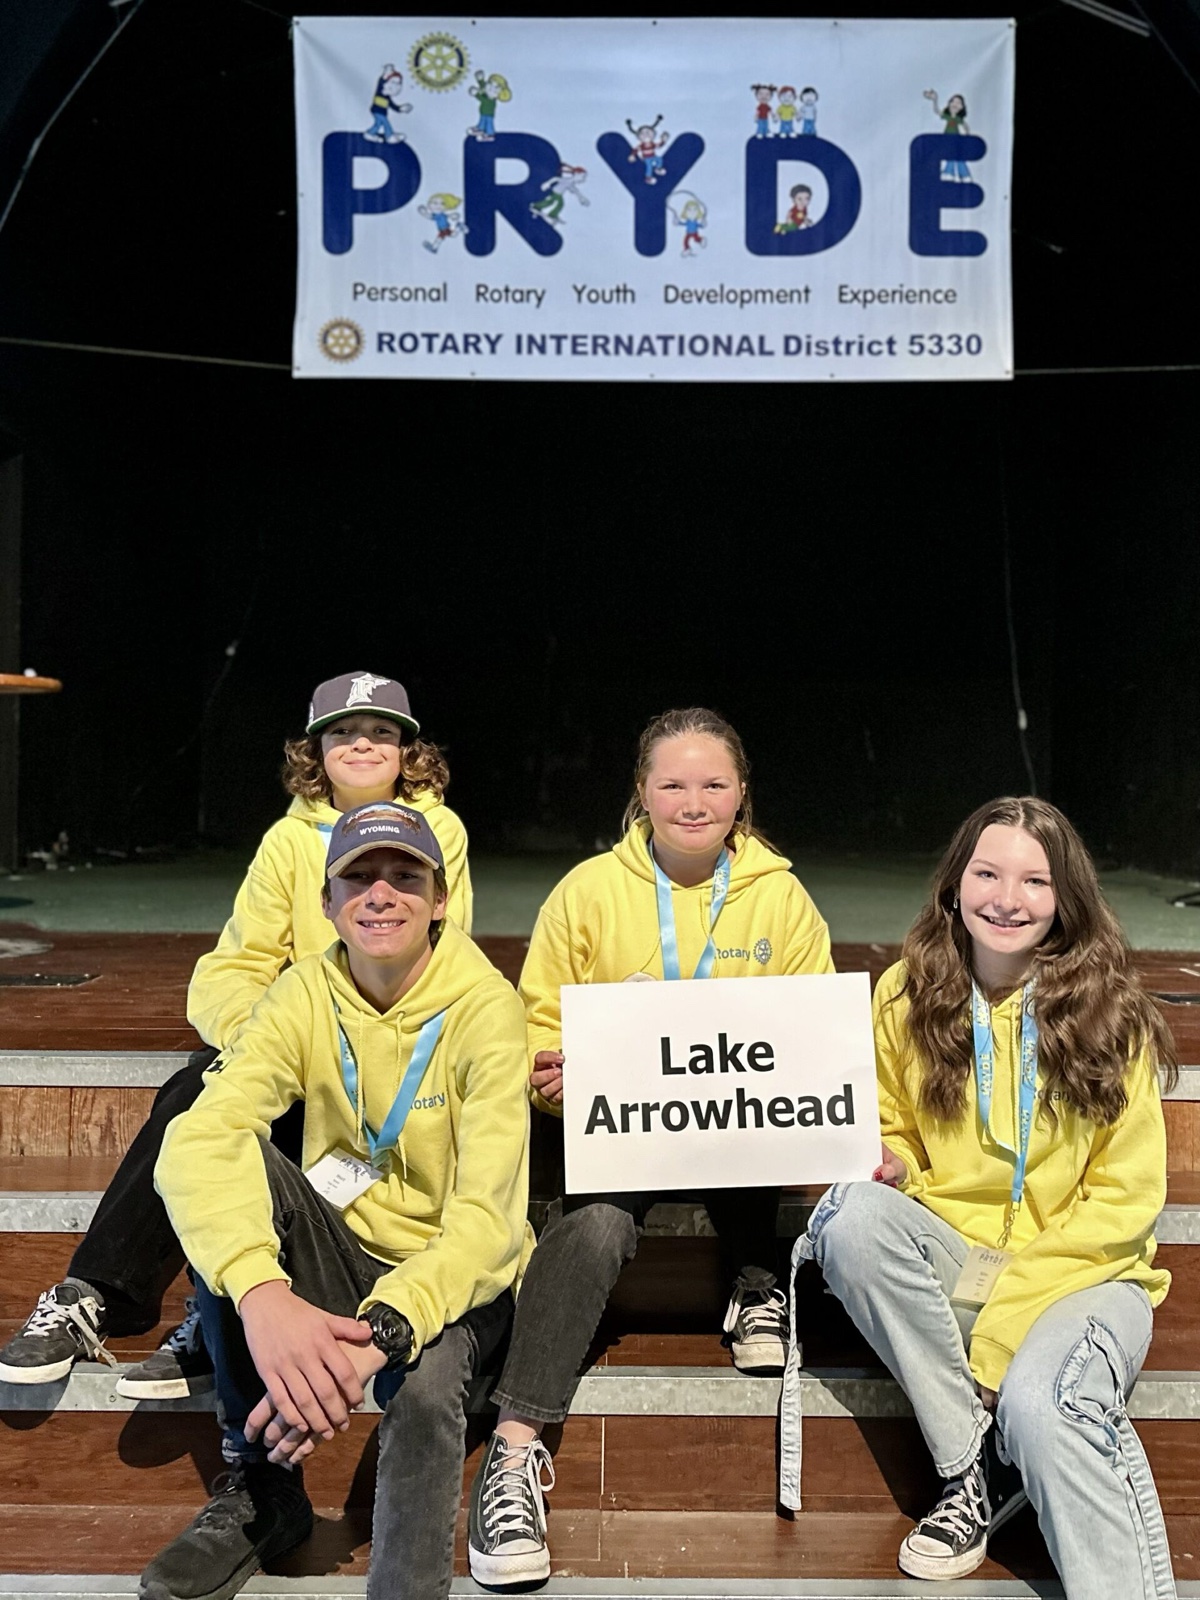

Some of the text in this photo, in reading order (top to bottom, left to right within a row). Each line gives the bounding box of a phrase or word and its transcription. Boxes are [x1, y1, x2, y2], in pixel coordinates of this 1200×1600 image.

[322, 131, 988, 257] PRYDE
[353, 282, 957, 309] Personal Rotary Youth Development Experience
[376, 332, 503, 354] ROTARY
[516, 333, 774, 356] INTERNATIONAL
[783, 334, 897, 356] District
[908, 333, 983, 356] 5330
[360, 825, 400, 836] WYOMING
[660, 1032, 775, 1075] Lake
[411, 1092, 446, 1110] otary
[584, 1083, 855, 1135] Arrowhead
